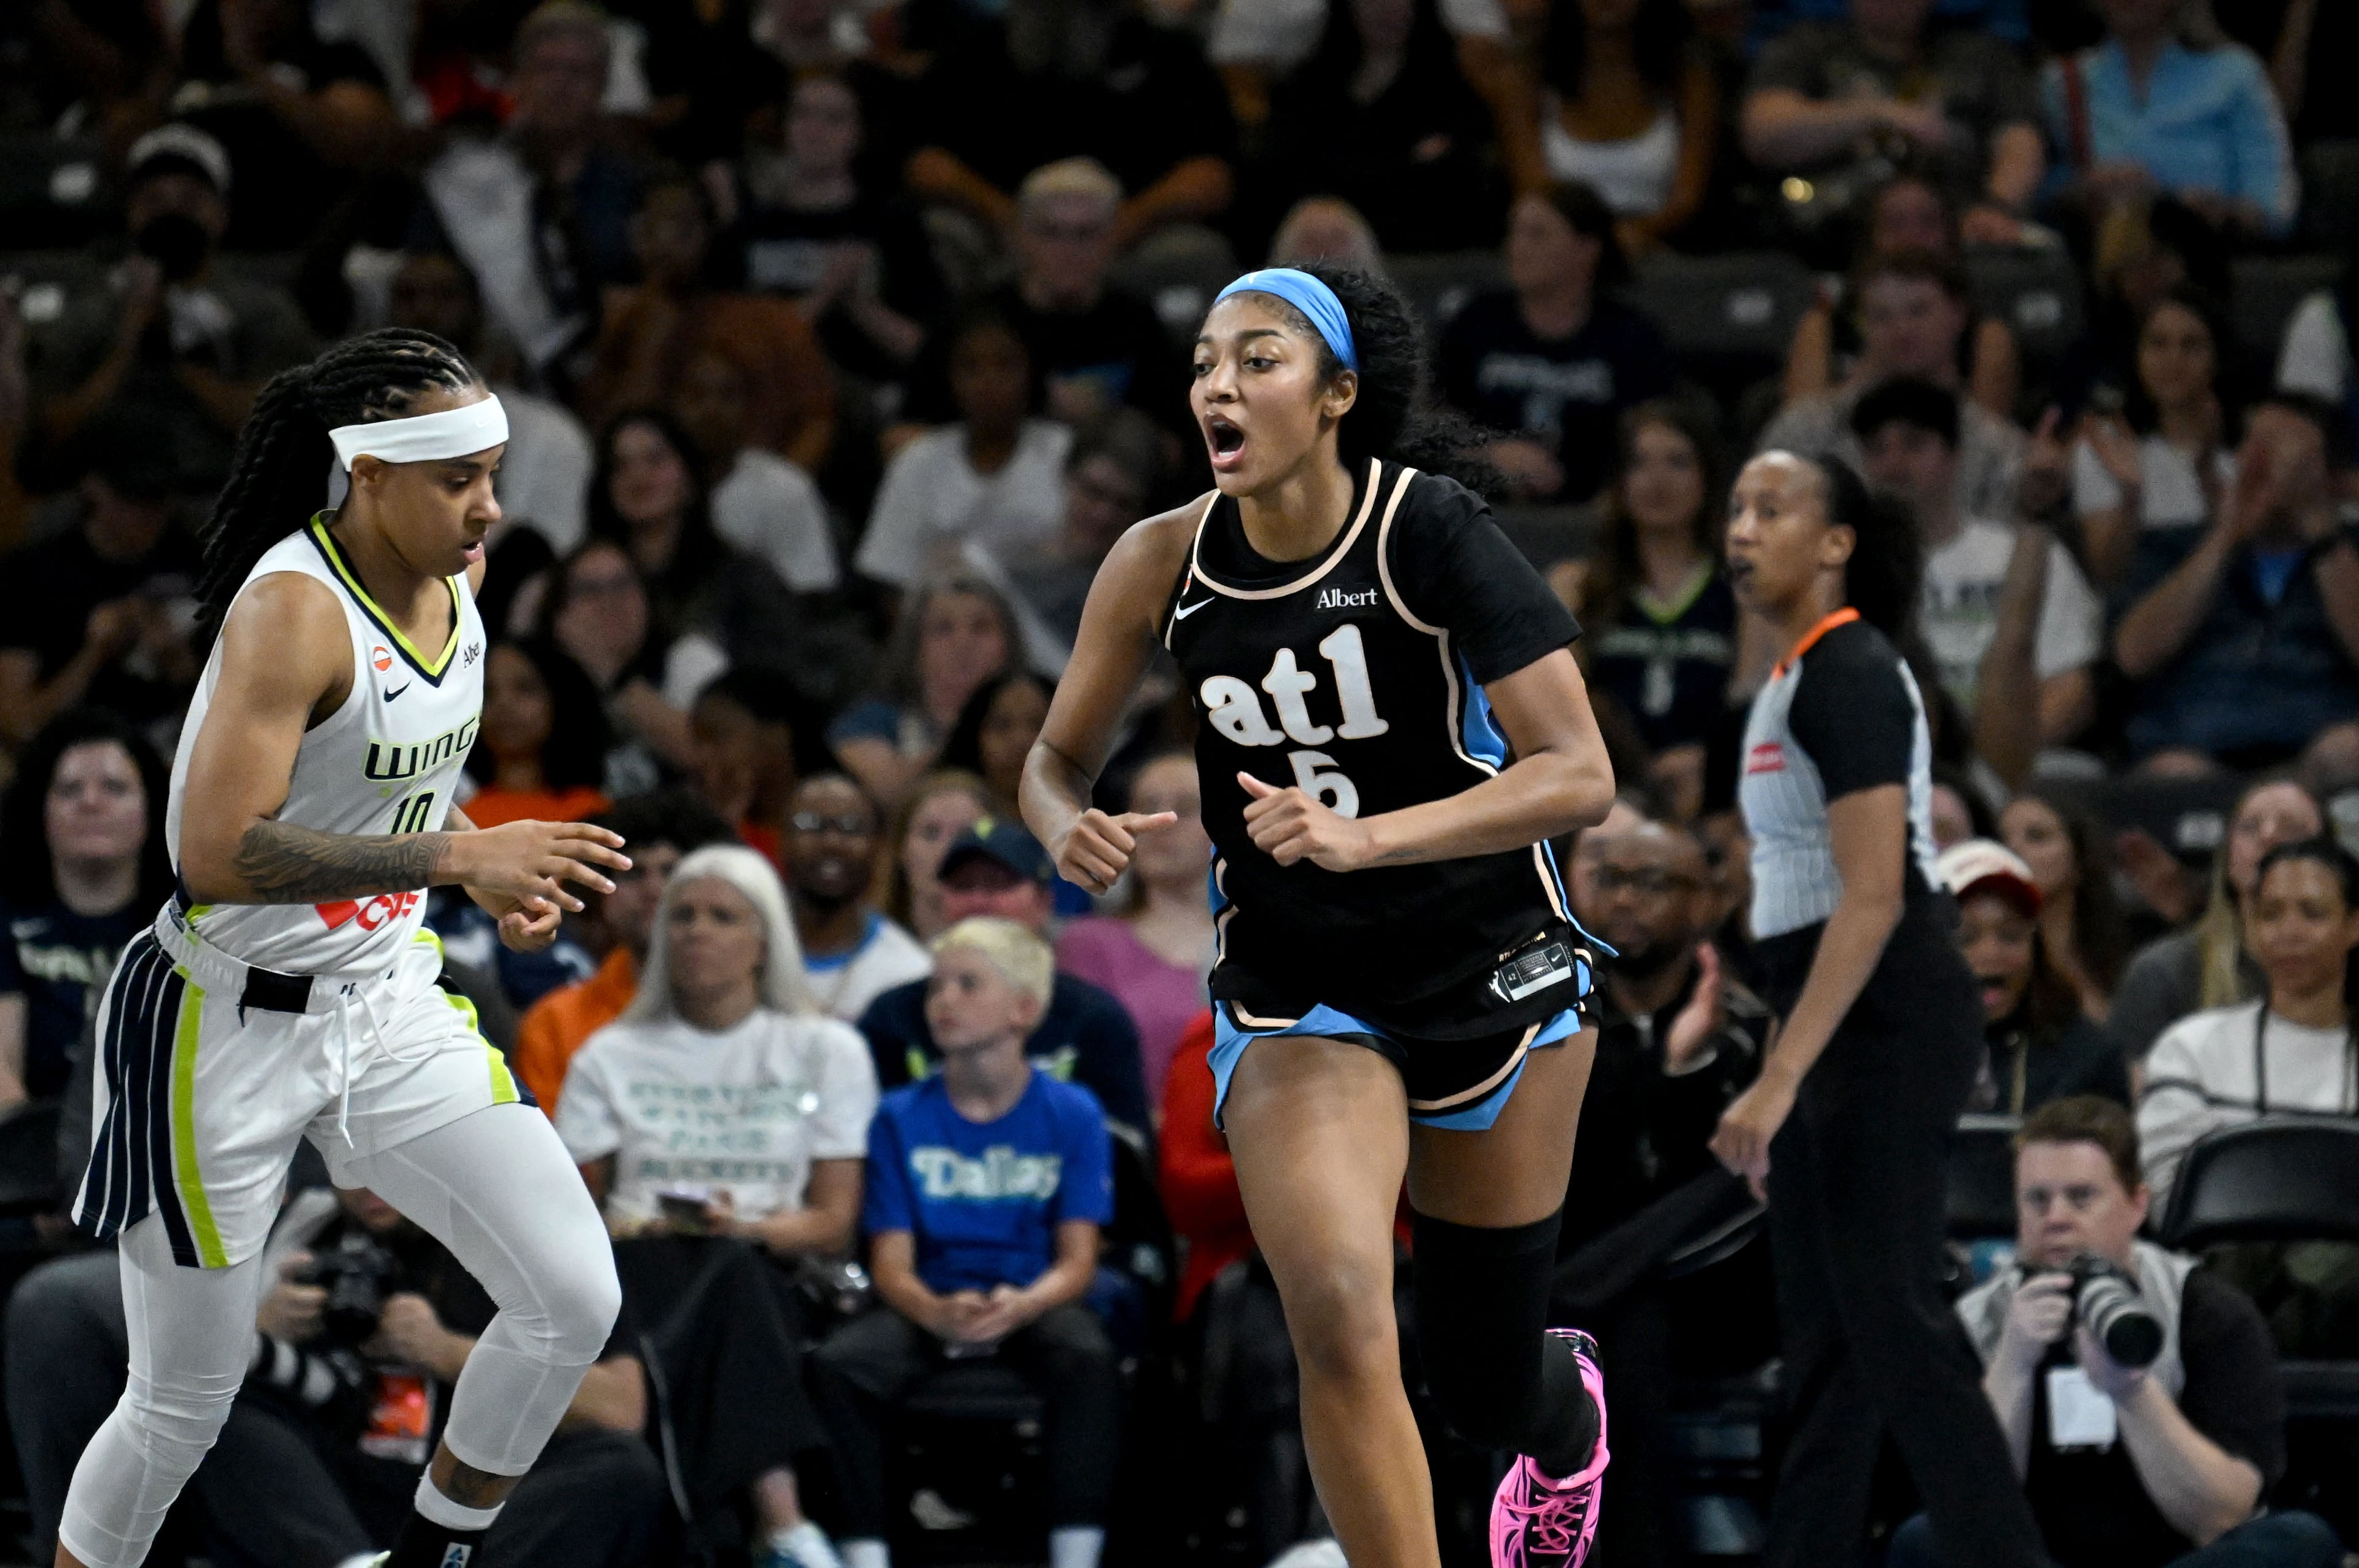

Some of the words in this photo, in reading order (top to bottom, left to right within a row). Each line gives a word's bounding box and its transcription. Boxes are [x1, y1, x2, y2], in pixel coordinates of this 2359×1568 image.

[1316, 588, 1378, 609] Albert
[1287, 750, 1359, 819] 5
[391, 791, 435, 835] 10
